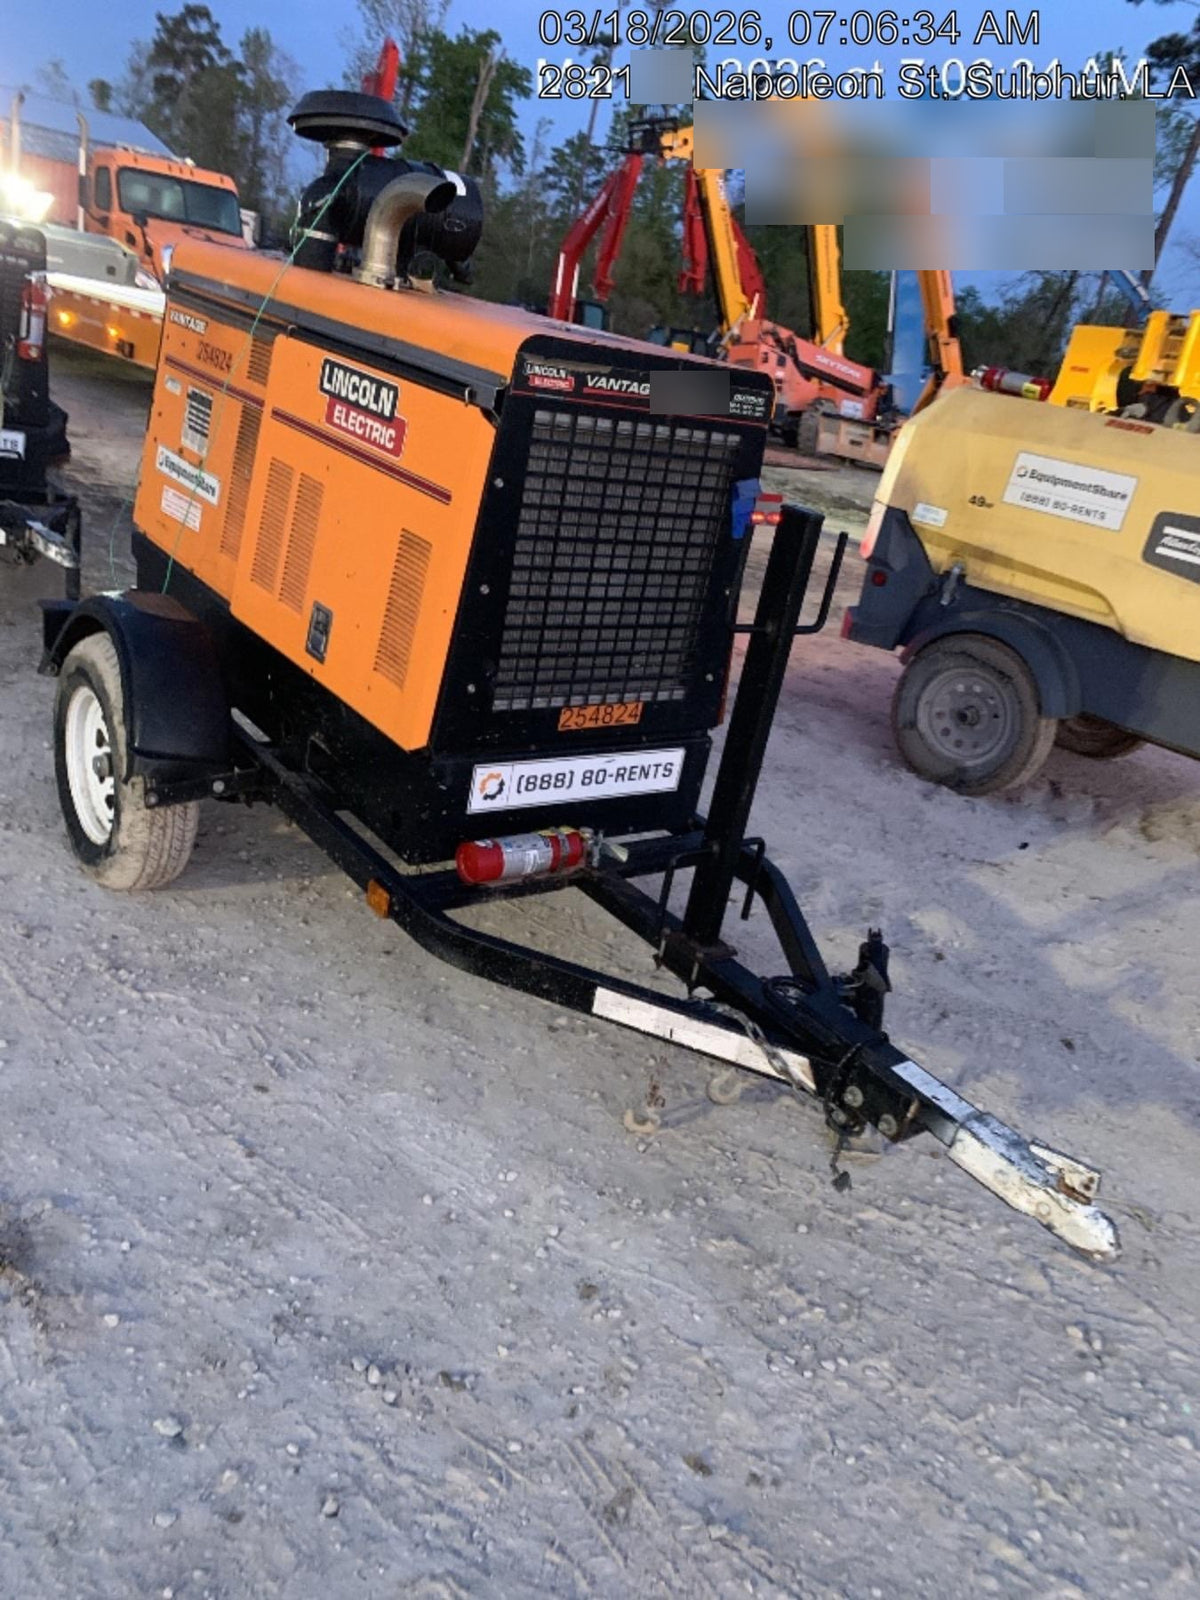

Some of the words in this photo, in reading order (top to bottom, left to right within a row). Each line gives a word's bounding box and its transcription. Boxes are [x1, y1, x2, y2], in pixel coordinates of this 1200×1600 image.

[526, 363, 567, 379] LINCOLN
[586, 374, 650, 396] VANTAG
[322, 363, 395, 418] LINCOLN
[333, 404, 397, 450] ELECTRIC
[1028, 468, 1129, 501] EquipmentShare
[1052, 500, 1108, 521] 80-RENTS
[559, 702, 640, 729] 254824
[516, 772, 574, 794] (888)
[580, 762, 675, 785] 80-RENTS
